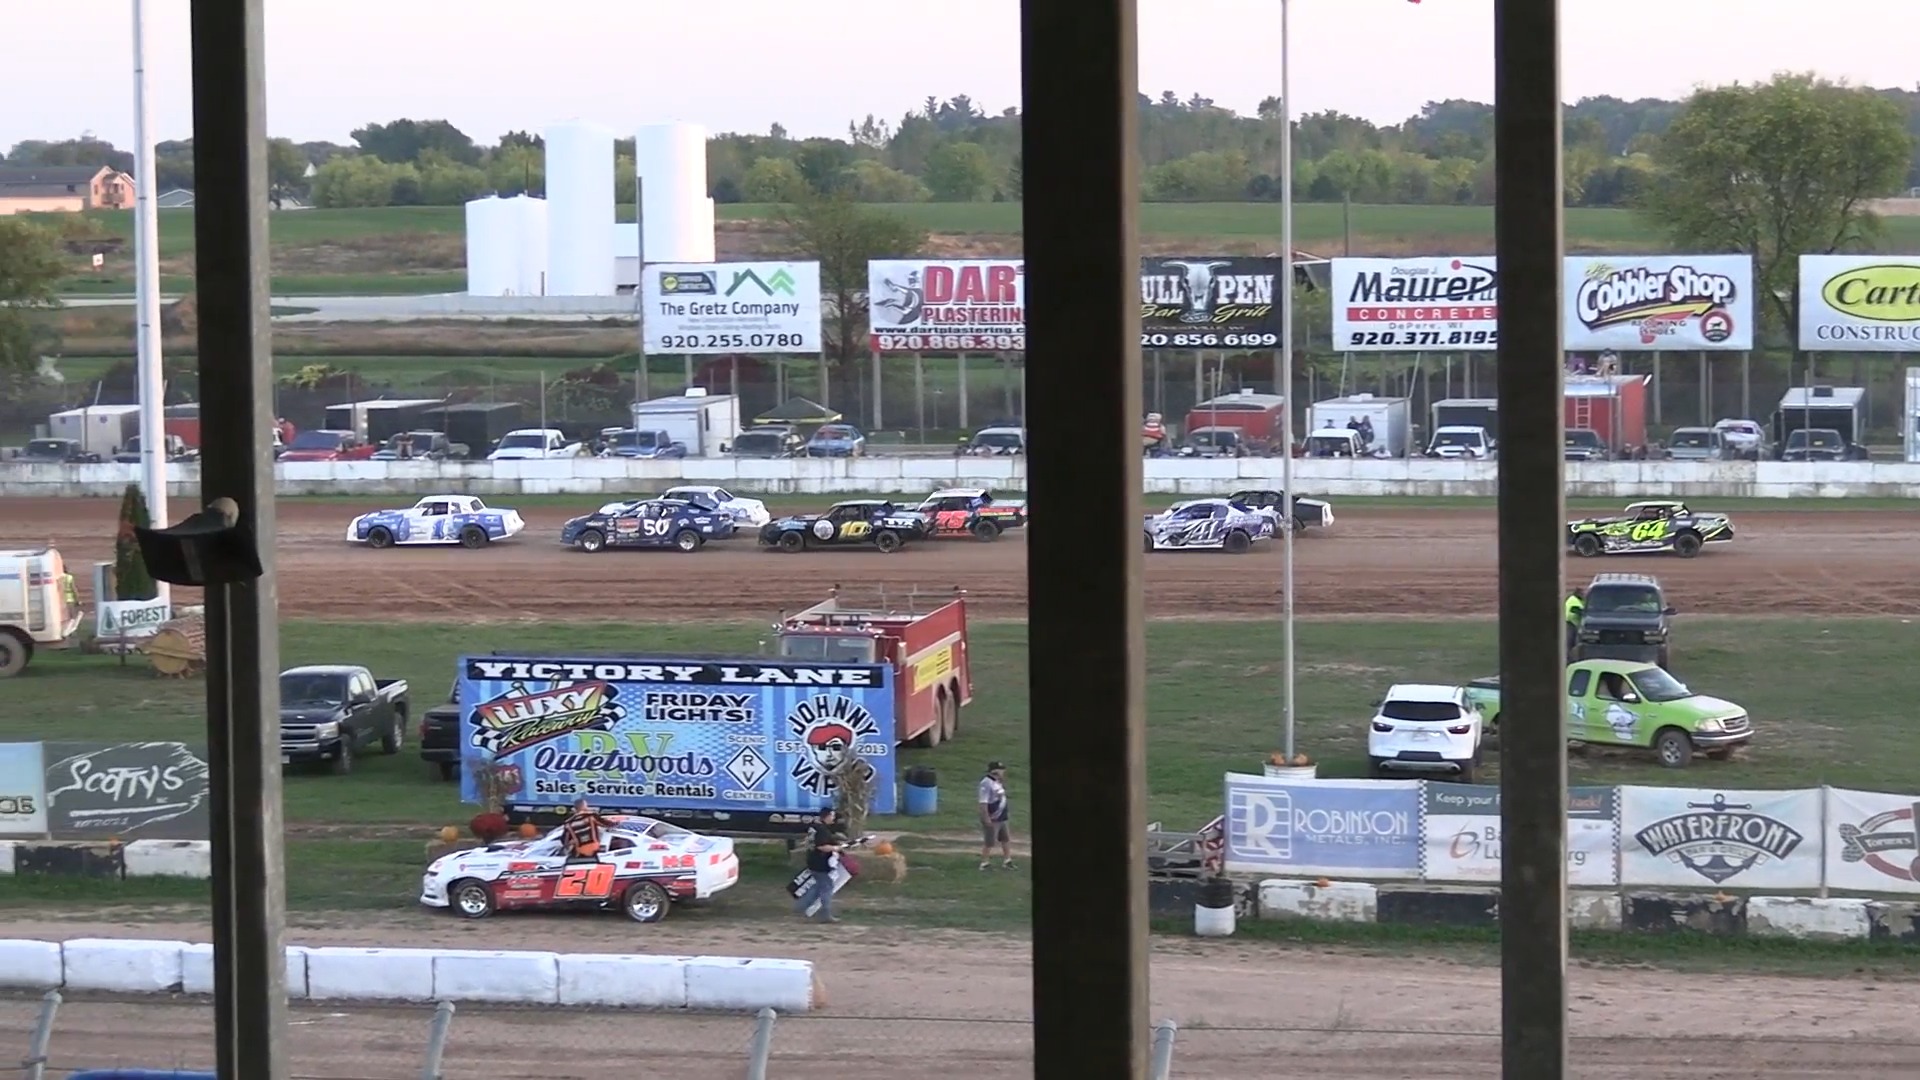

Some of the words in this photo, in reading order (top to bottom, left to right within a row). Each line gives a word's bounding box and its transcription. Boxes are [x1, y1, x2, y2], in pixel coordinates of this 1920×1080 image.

[1141, 275, 1183, 304] ULL
[1216, 275, 1274, 304] PEN
[1349, 272, 1486, 302] Maurer
[1578, 270, 1666, 322] Cobbler
[1668, 266, 1731, 304] Shop
[1836, 278, 1920, 305] Cart
[659, 302, 685, 315] The
[690, 302, 727, 315] Gretz
[732, 302, 799, 316] Company
[922, 307, 1025, 323] PLASTERIN
[1213, 304, 1272, 323] Grill
[1359, 308, 1493, 320] CONCRETE
[874, 326, 1025, 334] www.dartplastering.c
[1817, 325, 1920, 340] CONSTRUC
[661, 333, 803, 348] 920.255.0780
[878, 335, 1025, 349] 920.866.393
[1632, 521, 1667, 541] 64
[120, 605, 168, 625] FOREST
[475, 662, 702, 681] VICTORY
[721, 667, 870, 684] LANE
[646, 693, 752, 708] FRIDAY
[645, 708, 753, 722] LIGHTS!
[788, 695, 880, 737] JOHNNY
[728, 735, 767, 743] SCENIC
[857, 744, 888, 754] 2013
[535, 747, 714, 775] Quietwoods
[537, 780, 576, 793] Sales
[588, 781, 644, 795] Service
[656, 783, 714, 797] Rentals
[724, 791, 774, 800] CENTERS
[1435, 793, 1464, 805] Keep
[1467, 796, 1493, 807] your
[1294, 809, 1408, 835] ROBINSON
[1642, 815, 1798, 854] WATERFRONT
[558, 866, 615, 897] 20
